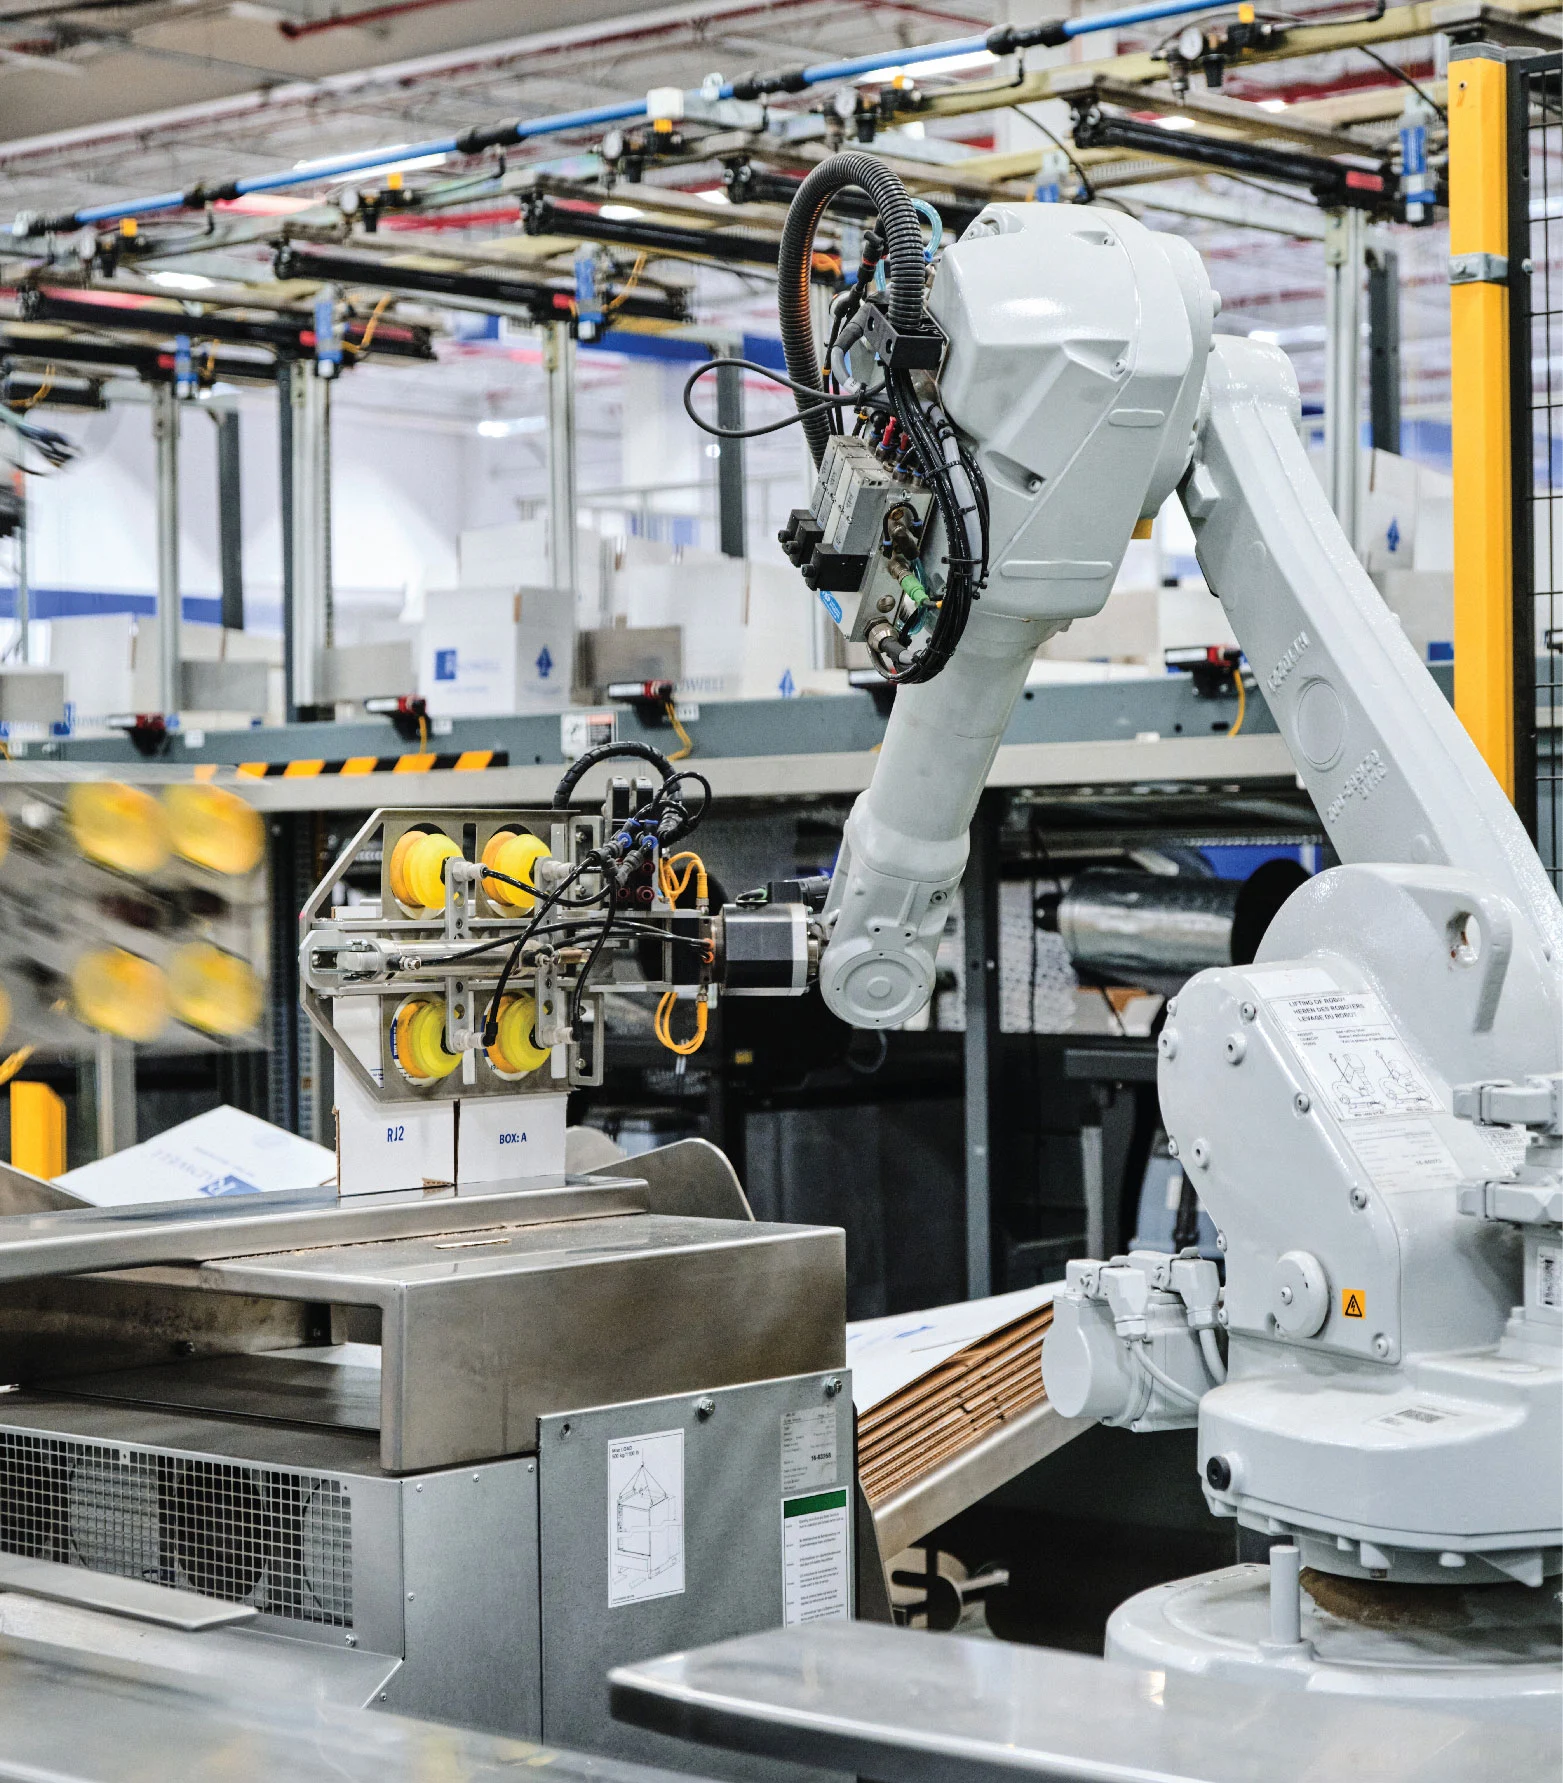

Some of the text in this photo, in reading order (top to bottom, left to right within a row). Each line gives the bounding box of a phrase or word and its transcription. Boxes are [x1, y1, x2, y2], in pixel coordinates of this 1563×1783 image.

[387, 1125, 405, 1143] RJ2
[499, 1132, 527, 1145] BOX: A
